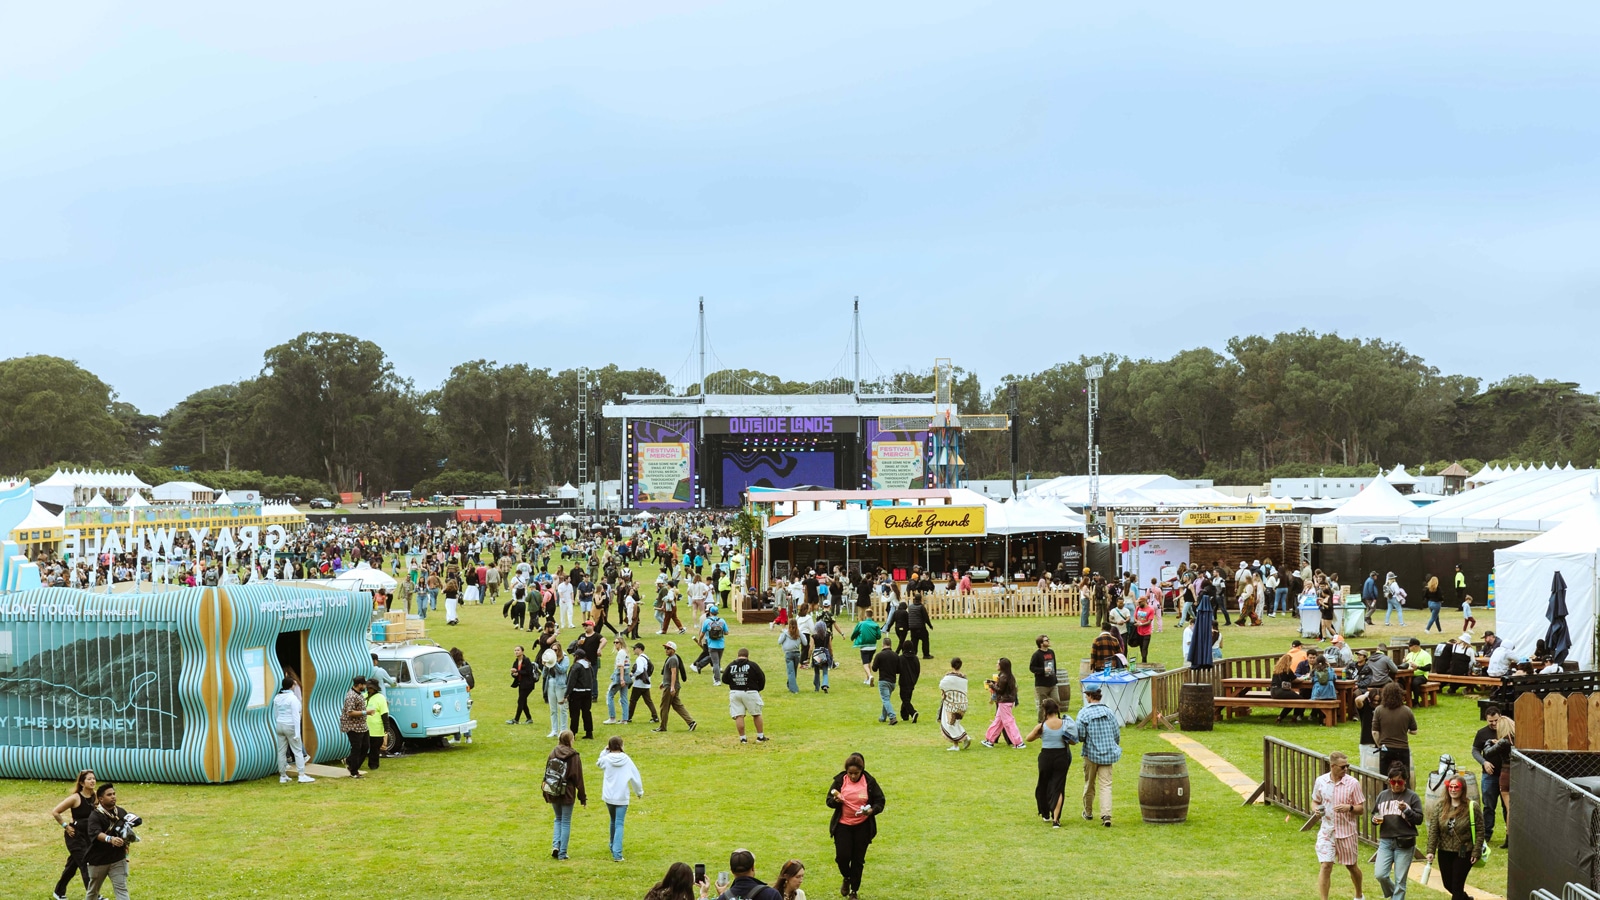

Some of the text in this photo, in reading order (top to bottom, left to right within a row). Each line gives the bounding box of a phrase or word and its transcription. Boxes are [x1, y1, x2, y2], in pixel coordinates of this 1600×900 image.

[729, 417, 833, 433] OUTSIDE LANDS
[884, 514, 970, 535] Outside Grounds
[324, 596, 348, 608] TOUR
[41, 603, 75, 615] TOUR
[730, 664, 738, 673] ZZ
[387, 698, 417, 707] HALE
[14, 717, 48, 728] THE
[53, 718, 136, 730] JOURNEY
